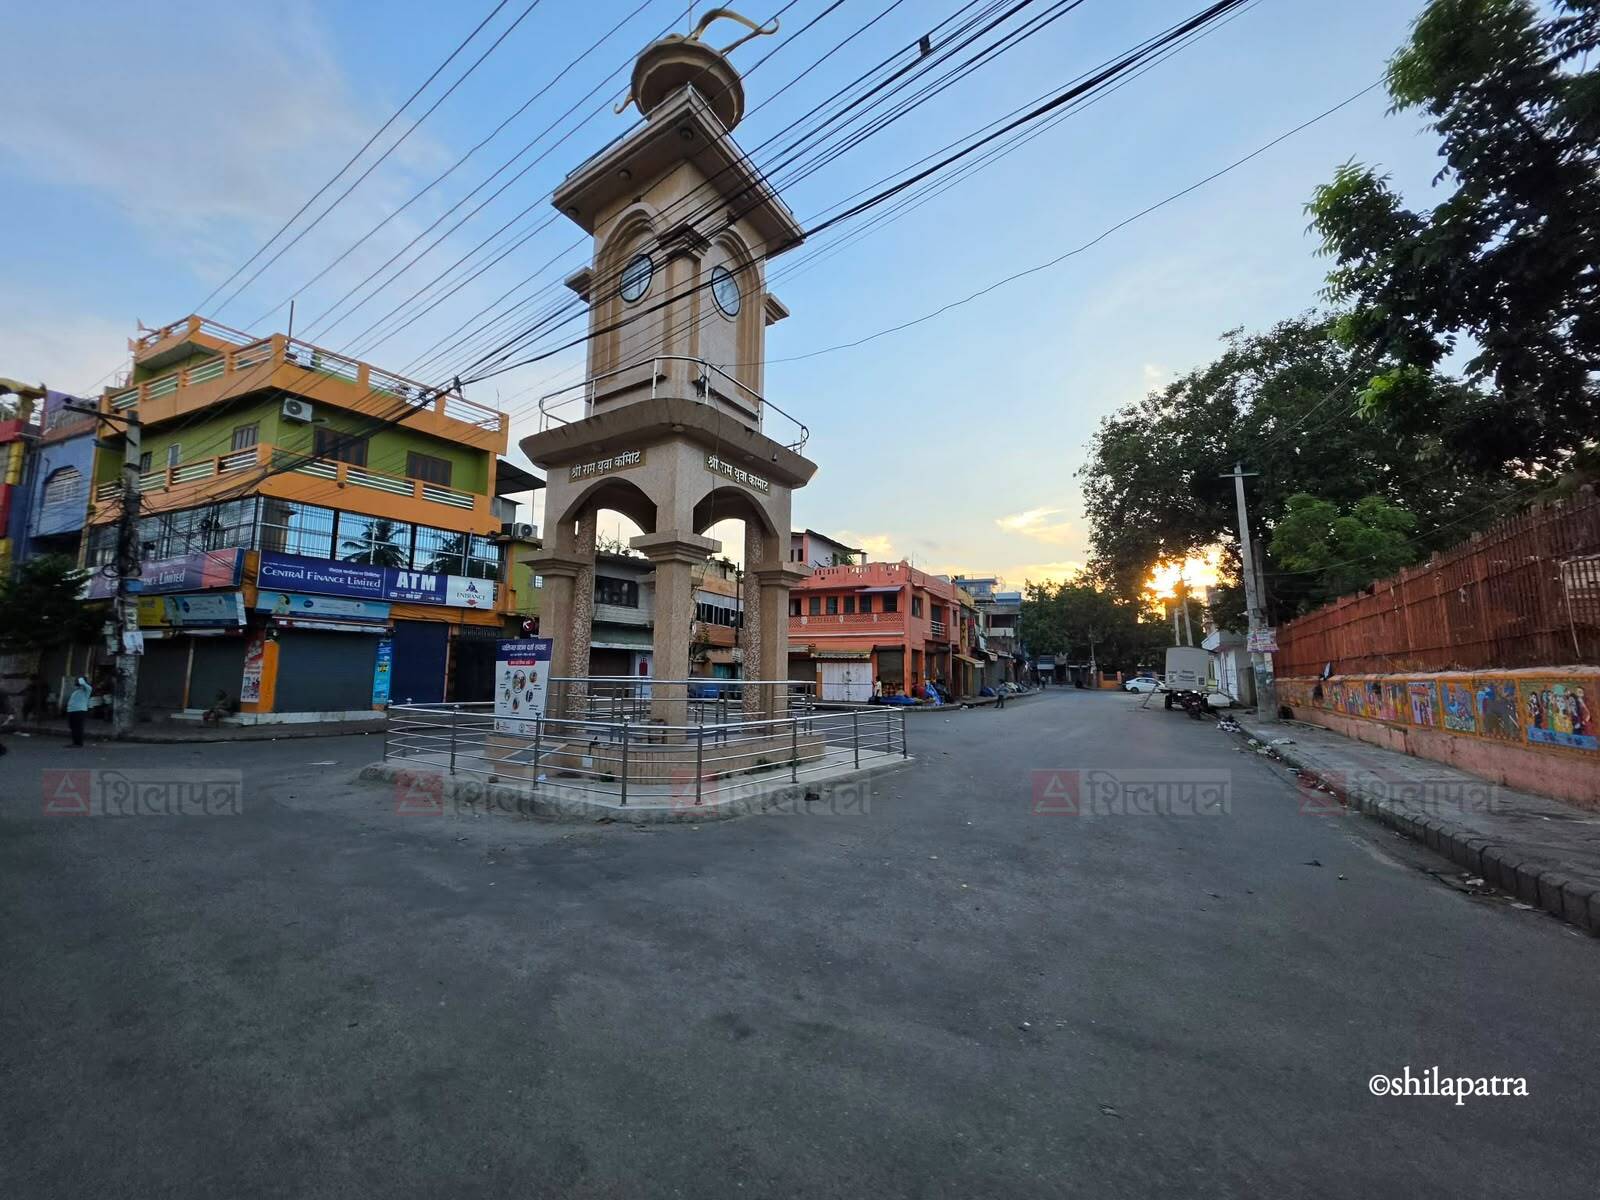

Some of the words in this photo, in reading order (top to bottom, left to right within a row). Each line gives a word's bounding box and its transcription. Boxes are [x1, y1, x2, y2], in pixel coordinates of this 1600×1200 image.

[571, 464, 582, 479] श्री
[583, 462, 596, 476] राम
[597, 458, 613, 474] युवा
[707, 455, 719, 471] श्री
[720, 461, 733, 476] राम
[734, 467, 748, 483] युवा
[396, 571, 437, 591] ATM
